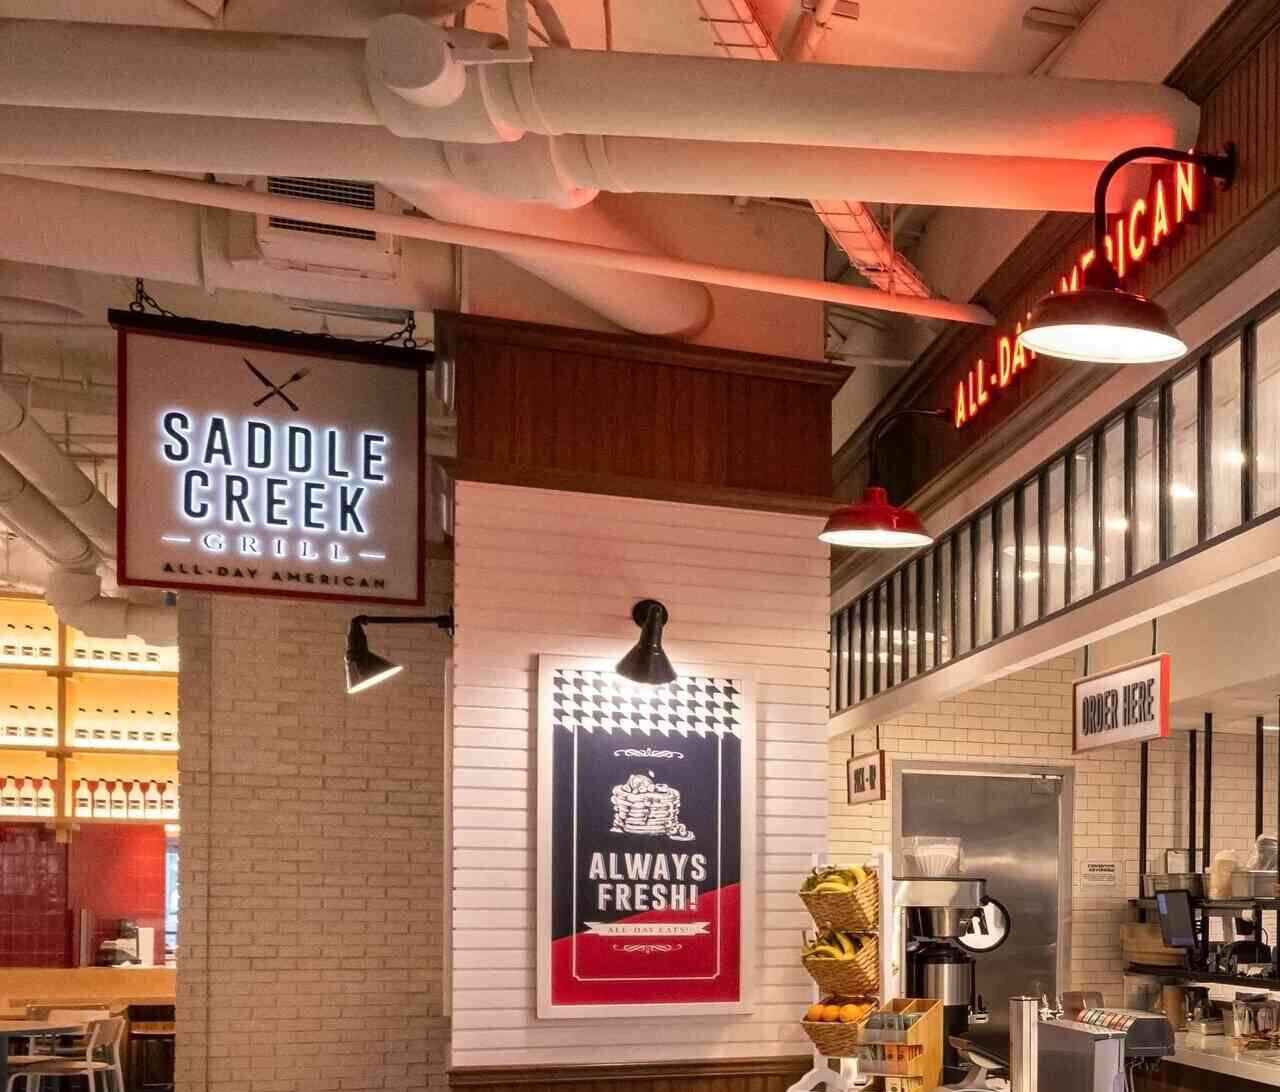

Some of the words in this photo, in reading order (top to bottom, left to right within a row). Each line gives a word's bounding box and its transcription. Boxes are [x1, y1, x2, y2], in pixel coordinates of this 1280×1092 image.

[955, 311, 1036, 428] ALL-DA
[162, 411, 385, 482] SADDLE
[183, 469, 366, 534] CREEK
[203, 532, 349, 562] GRILL
[163, 562, 258, 579] ALL-DAY
[271, 571, 385, 589] AMERICAN
[1082, 688, 1118, 736] ORDER
[1122, 678, 1154, 727] HERE
[589, 852, 707, 881] ALWAYS
[598, 883, 698, 912] FRESH!
